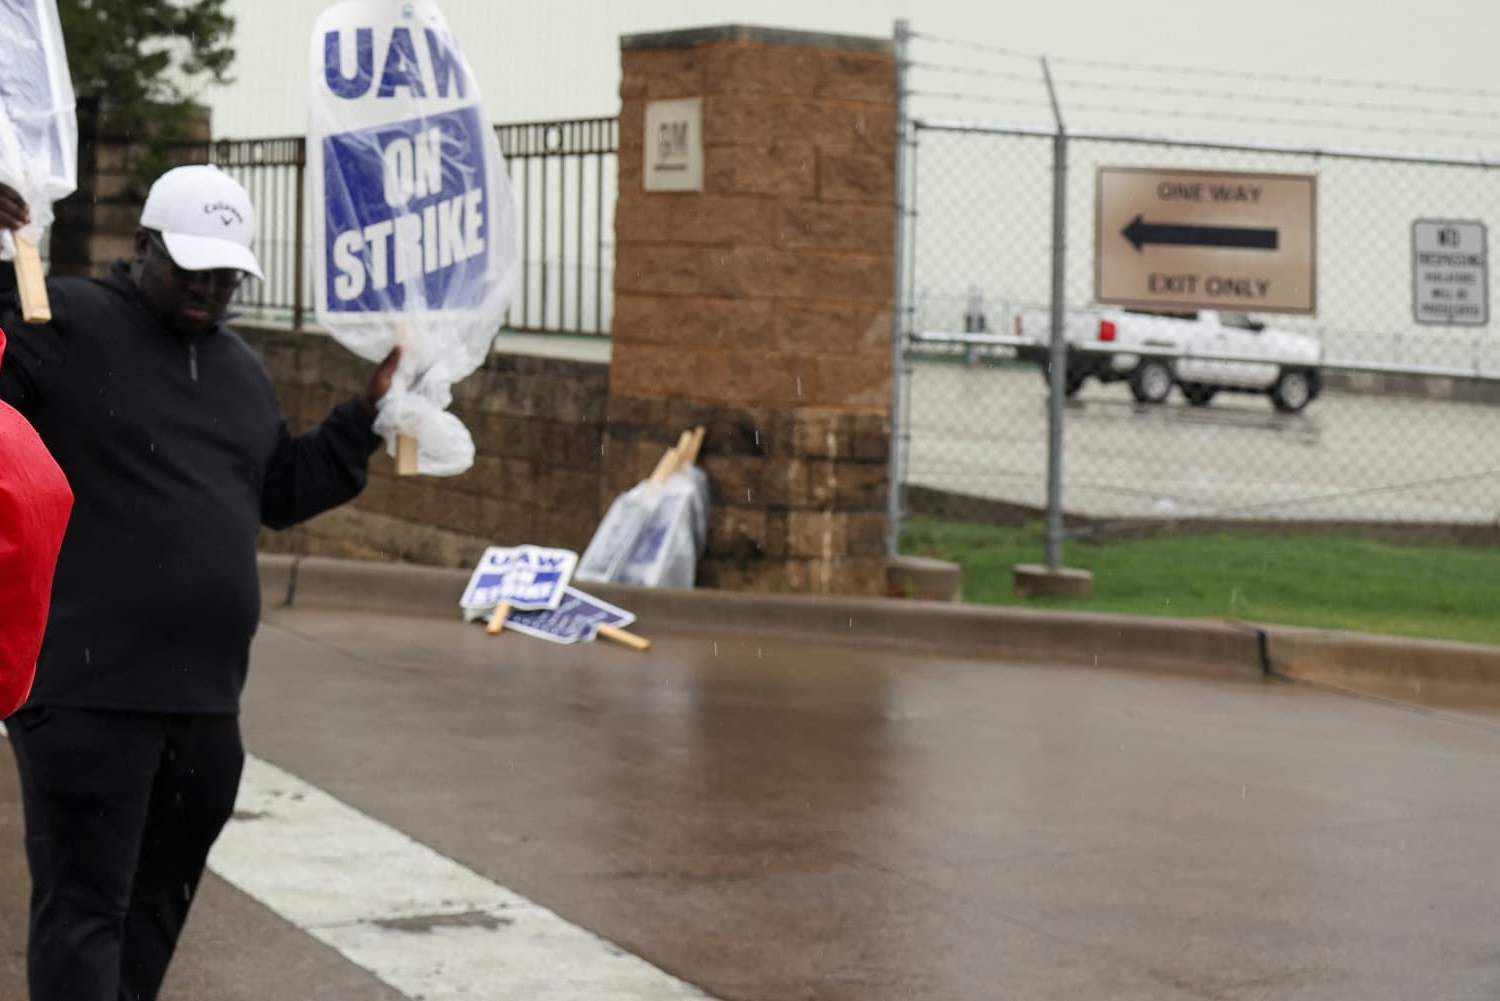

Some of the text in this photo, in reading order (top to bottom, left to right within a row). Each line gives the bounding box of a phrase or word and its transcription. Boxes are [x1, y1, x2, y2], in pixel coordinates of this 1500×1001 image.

[382, 126, 443, 208] ON
[1156, 181, 1263, 204] ONE WAY
[332, 188, 485, 301] STRIKE
[1147, 271, 1271, 298] EXIT ONLY
[489, 552, 565, 568] UAW
